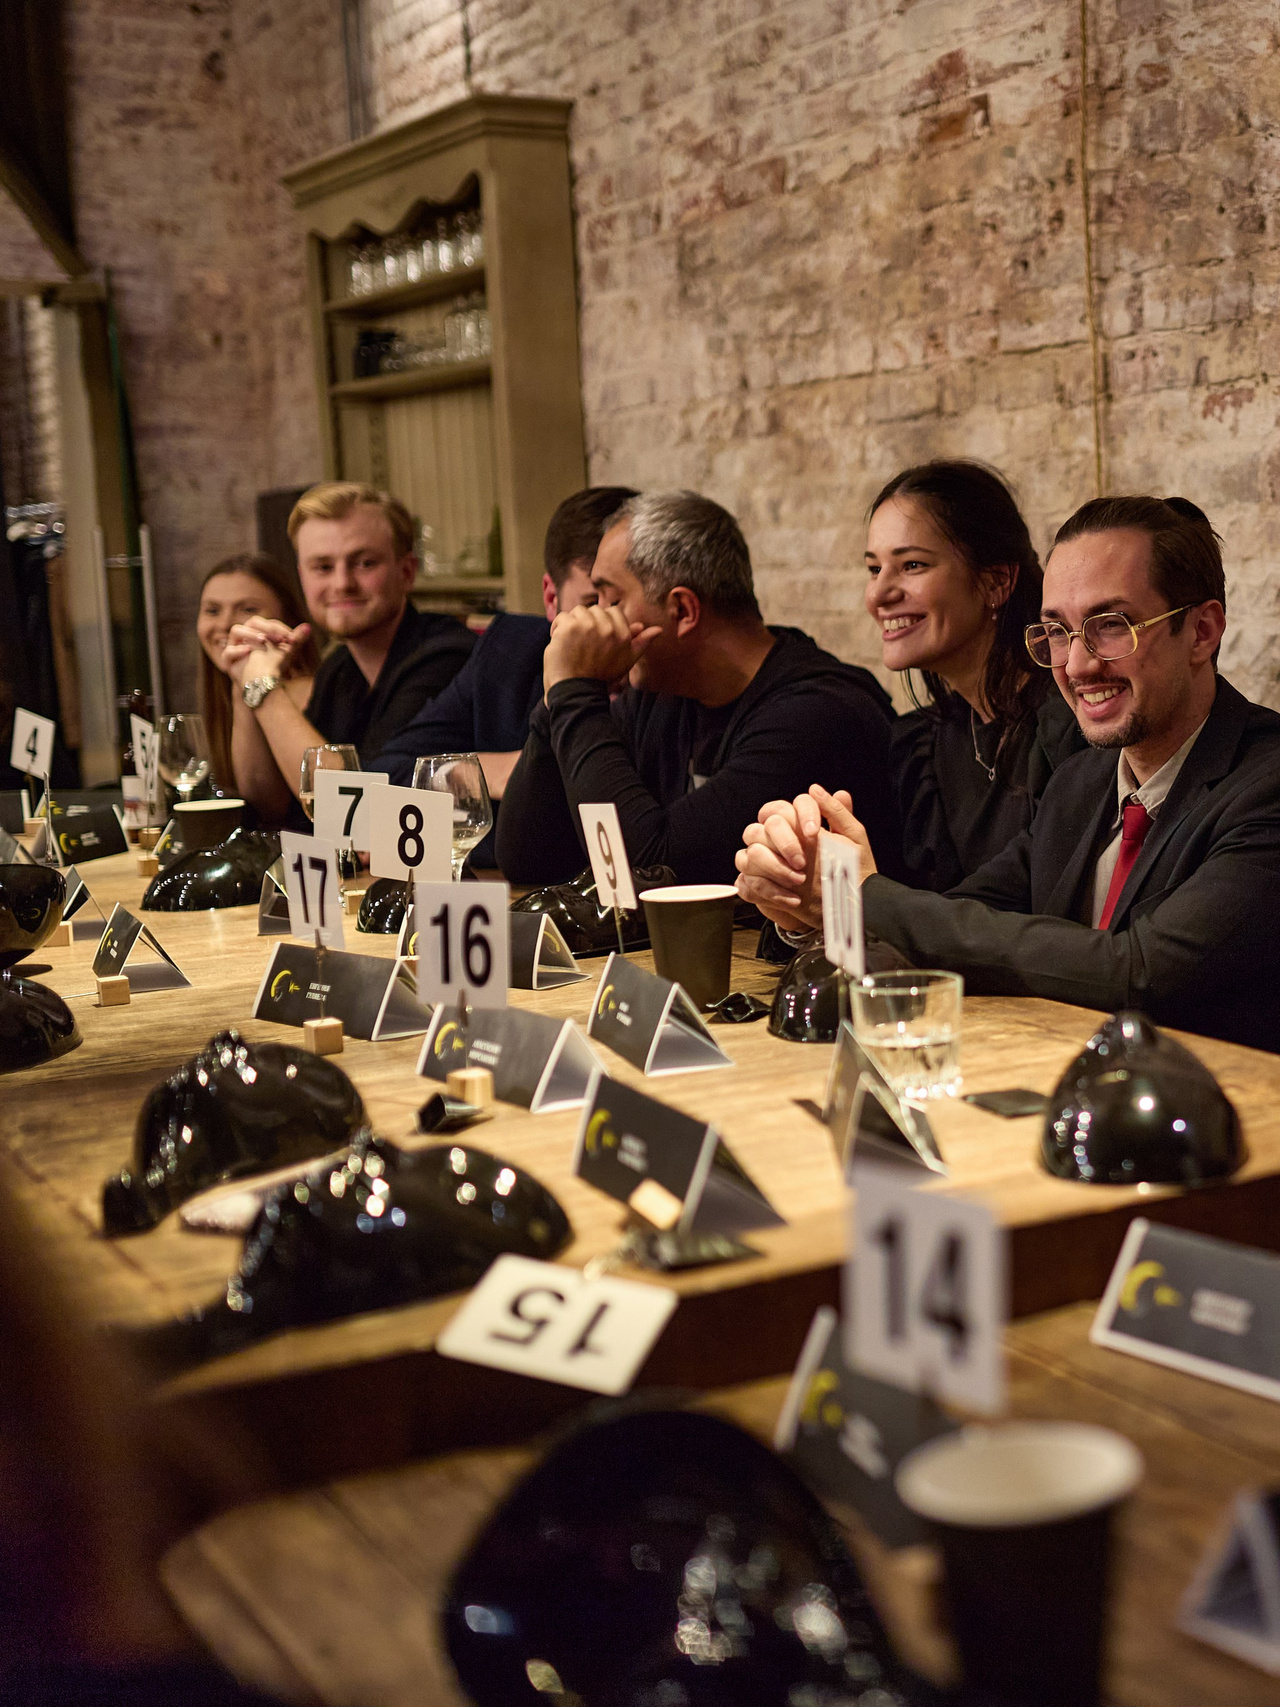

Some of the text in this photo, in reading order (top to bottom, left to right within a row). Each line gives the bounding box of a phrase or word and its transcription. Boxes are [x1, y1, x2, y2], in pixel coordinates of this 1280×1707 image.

[26, 726, 38, 763] 4
[338, 787, 364, 836] 7
[398, 804, 425, 867] 8
[292, 853, 328, 929] 17
[596, 820, 618, 891] 9
[829, 861, 853, 950] 10
[431, 903, 492, 988] 16
[488, 1286, 611, 1359] 15
[869, 1213, 972, 1364] 14
